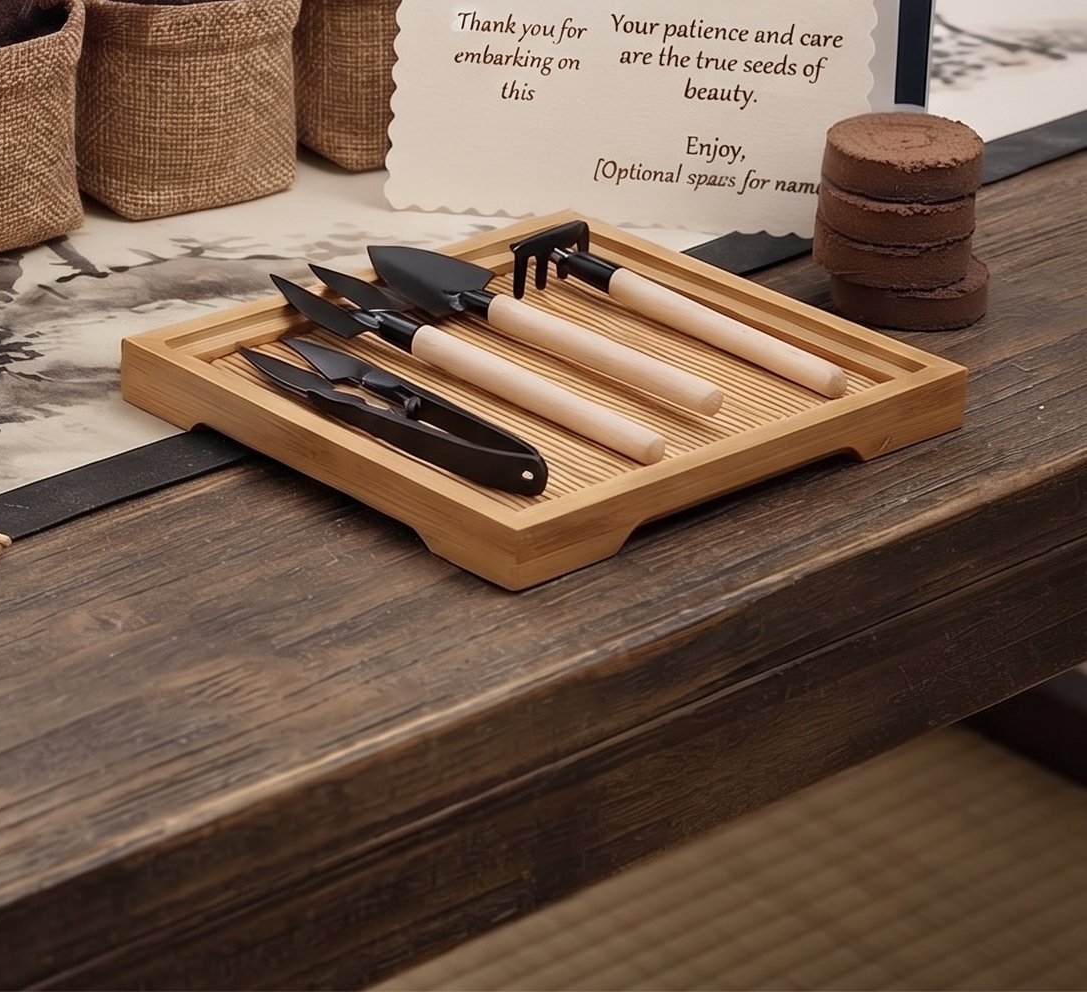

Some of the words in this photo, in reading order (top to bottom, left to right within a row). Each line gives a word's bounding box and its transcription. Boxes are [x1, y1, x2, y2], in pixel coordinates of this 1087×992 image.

[457, 11, 516, 34] Thank
[517, 23, 556, 43] you
[552, 17, 588, 45] for
[611, 13, 660, 36] Your
[662, 19, 749, 44] patience
[754, 23, 796, 46] and
[800, 32, 844, 48] care
[454, 44, 554, 76] embarking
[558, 58, 580, 71] on
[620, 50, 653, 65] are
[658, 45, 691, 68] the
[696, 51, 738, 72] true
[743, 54, 797, 76] seeds
[802, 57, 829, 84] of
[501, 80, 535, 101] this
[684, 77, 758, 110] beauty.
[686, 135, 746, 165] Enjoy,
[593, 158, 683, 185] [Optional
[737, 169, 771, 195] for
